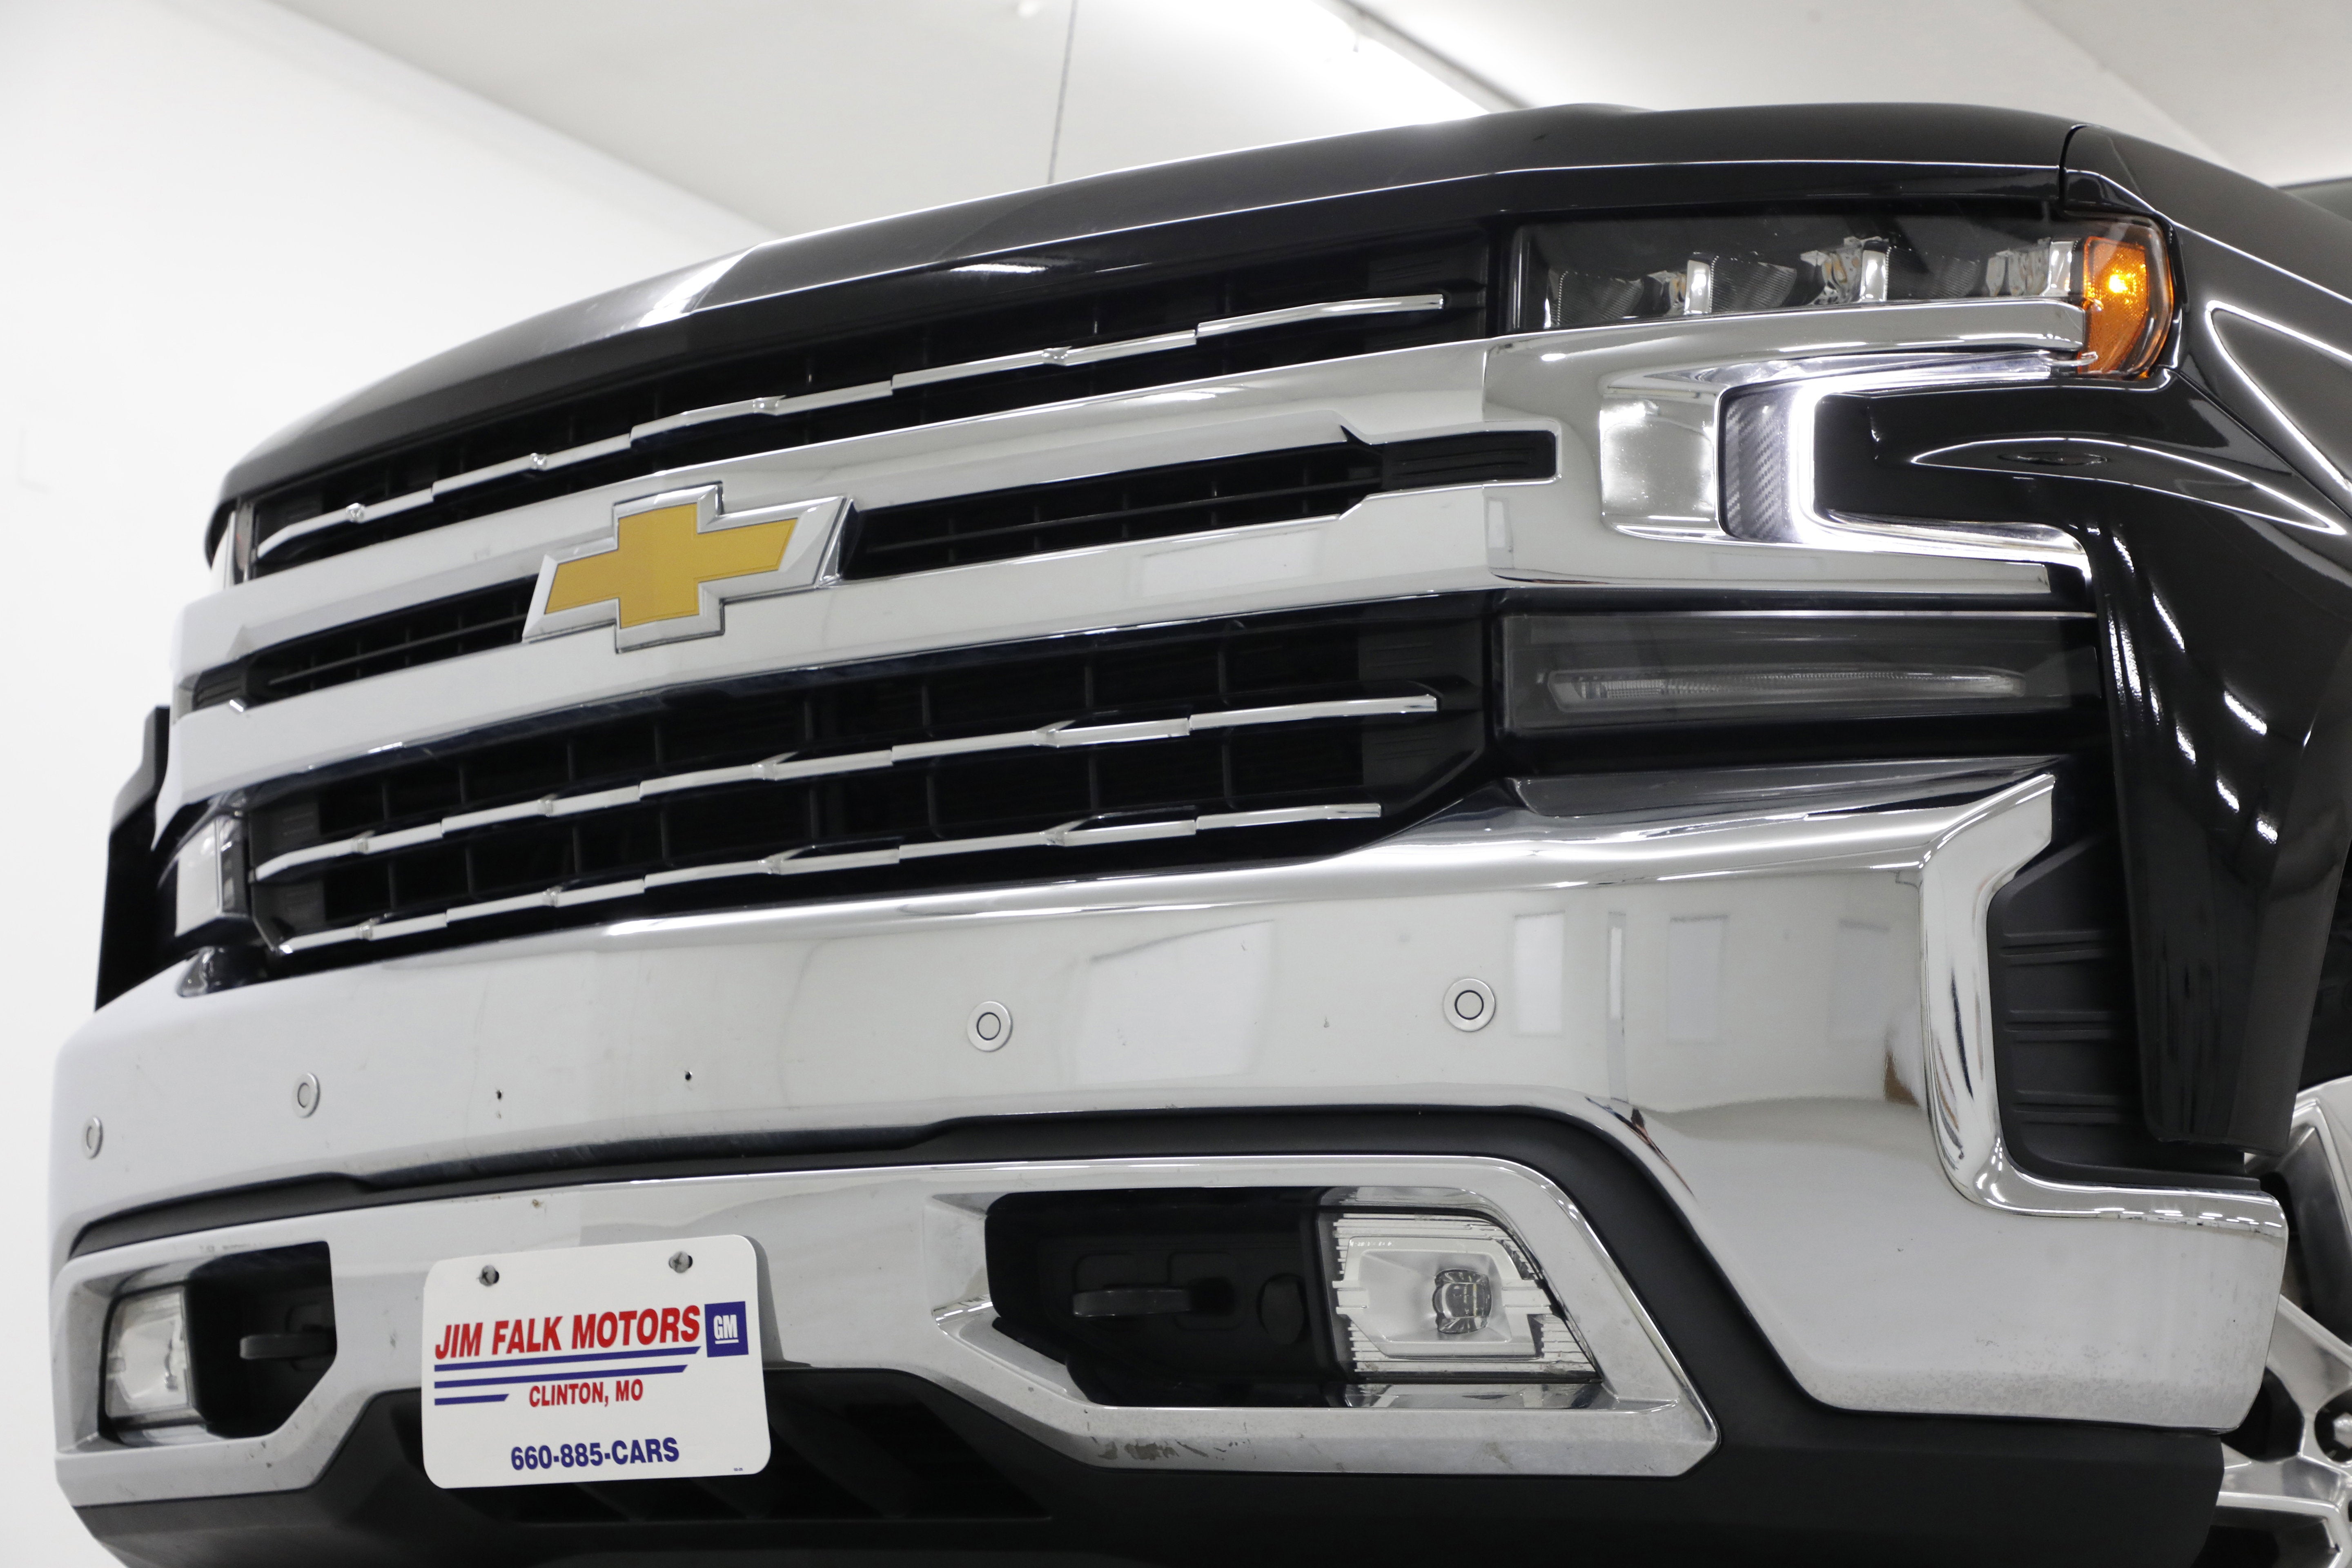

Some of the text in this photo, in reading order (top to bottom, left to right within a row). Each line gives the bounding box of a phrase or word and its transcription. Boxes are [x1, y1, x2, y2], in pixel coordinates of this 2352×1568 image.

[435, 1305, 701, 1360] JIM FALK MOTORS
[713, 1314, 738, 1340] GM
[529, 1379, 644, 1408] CLINTON, MO
[511, 1437, 679, 1470] 660-885-CARS
